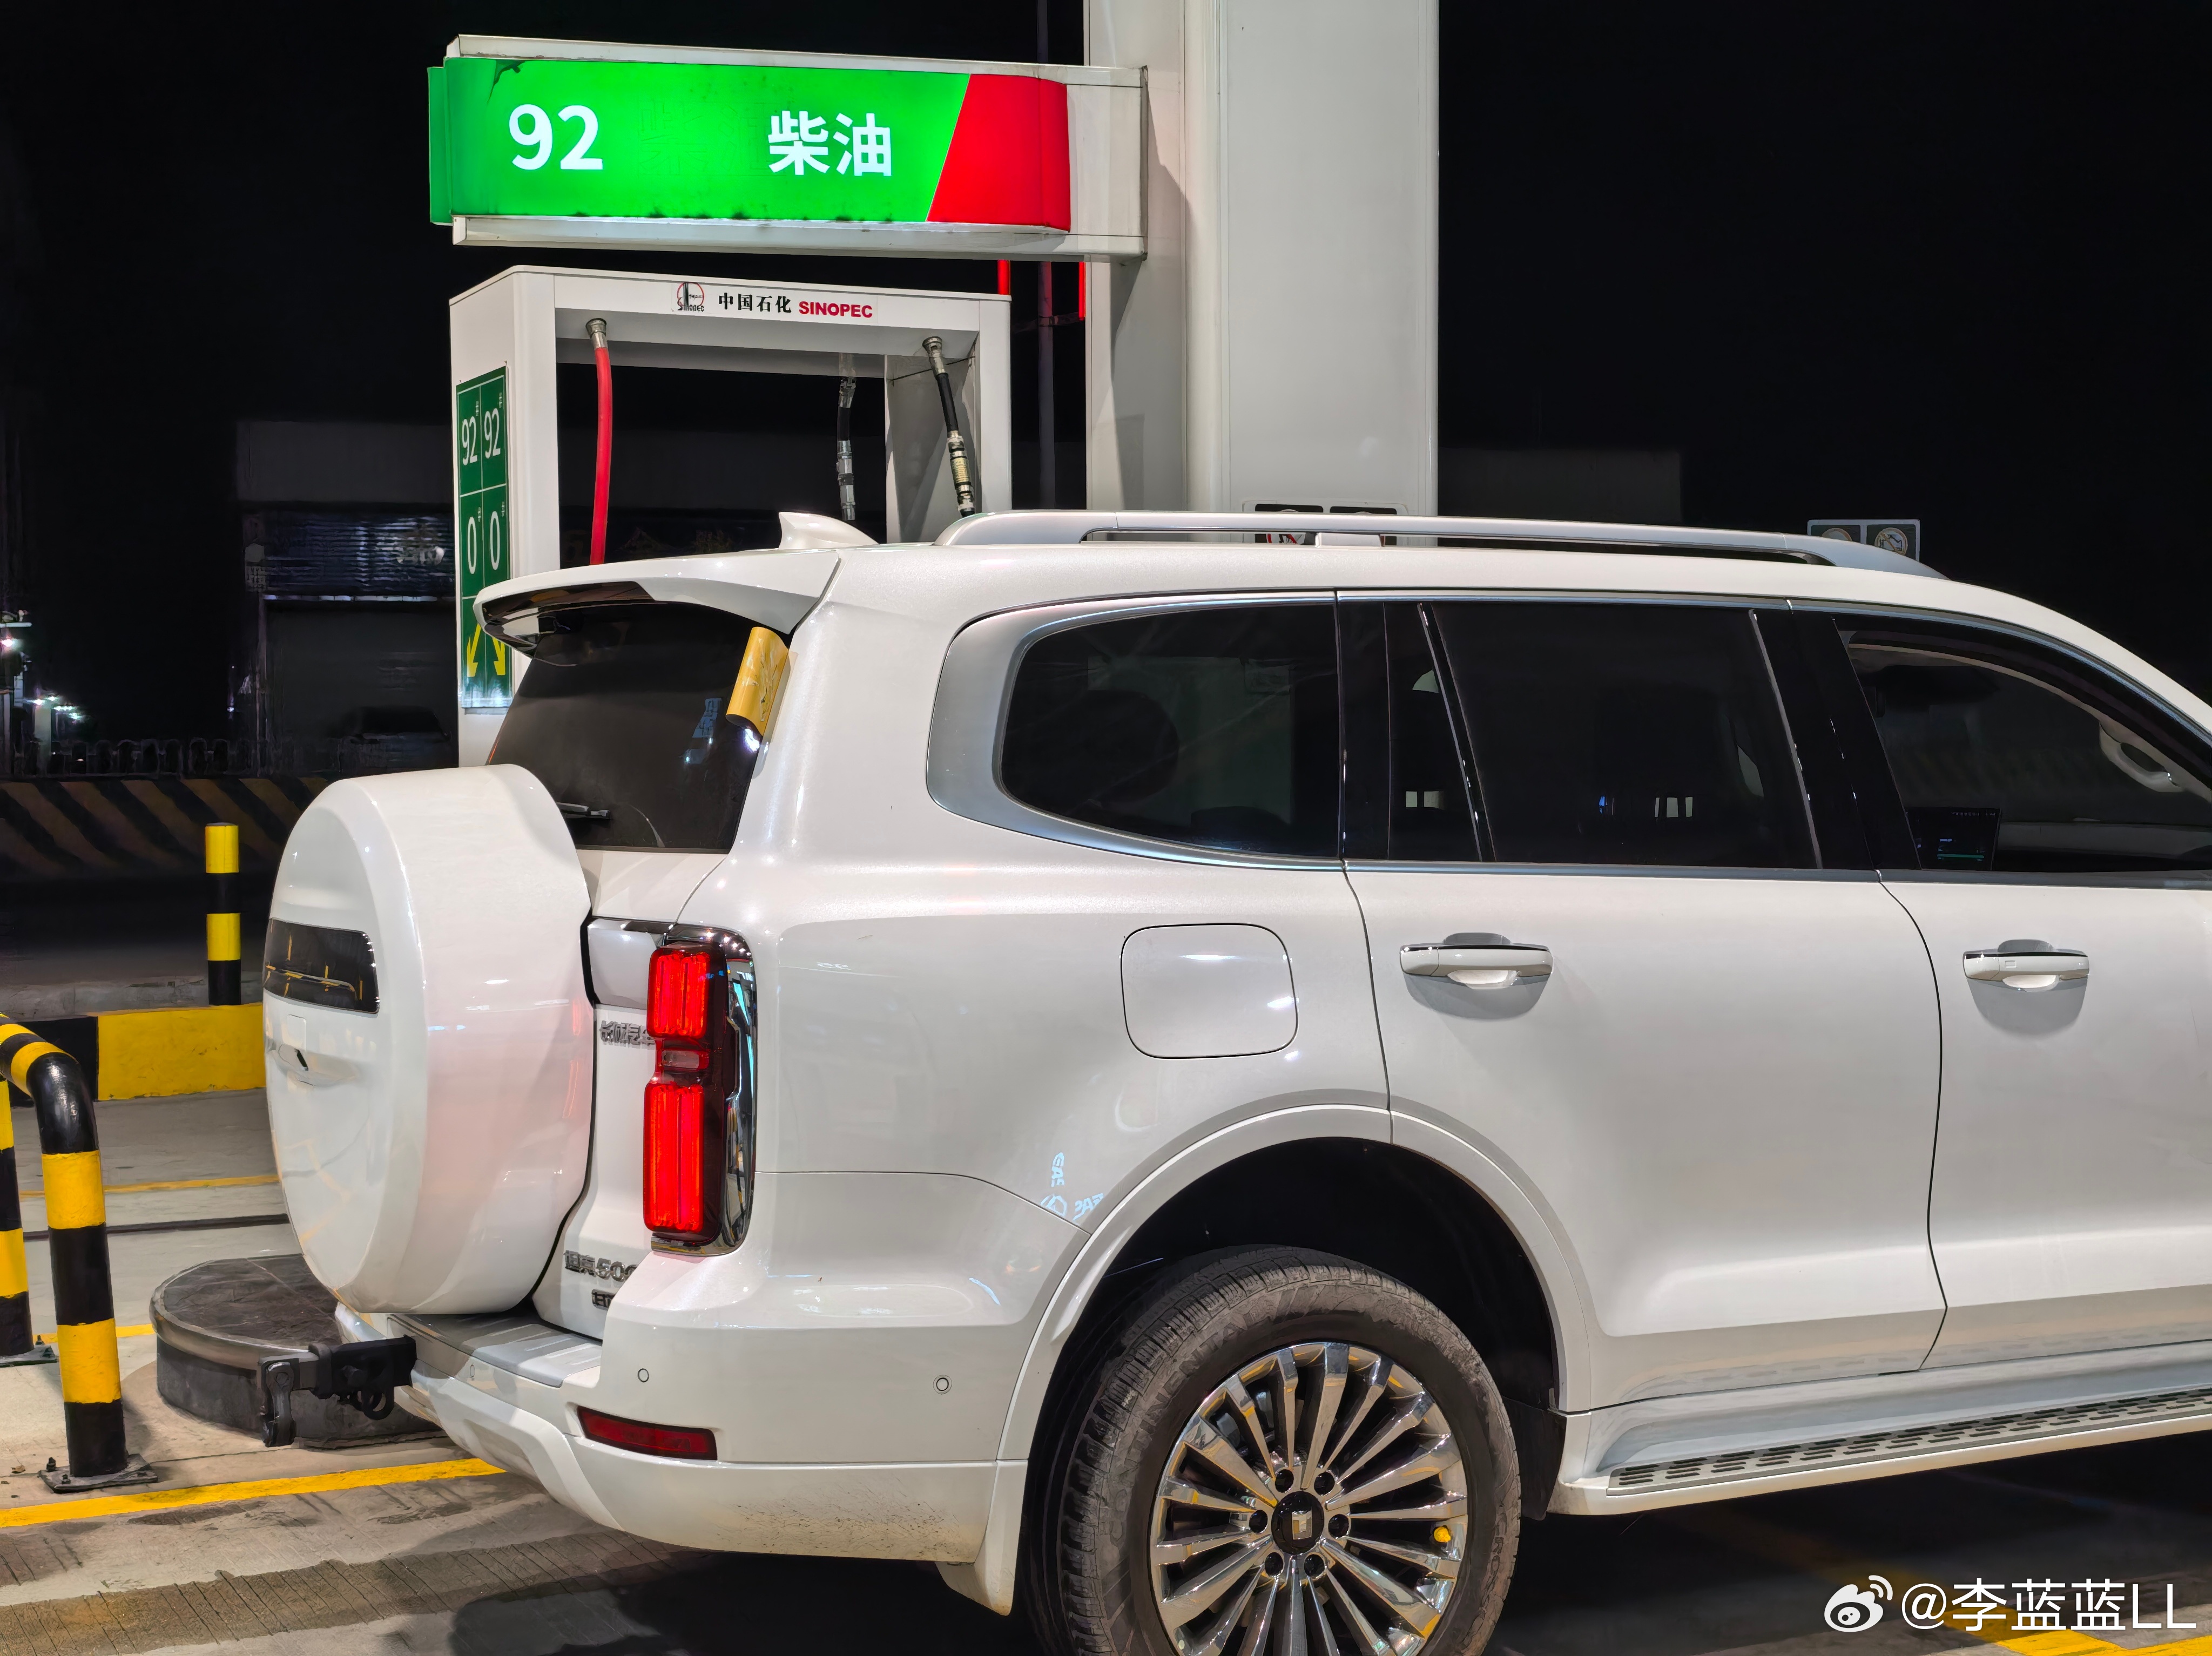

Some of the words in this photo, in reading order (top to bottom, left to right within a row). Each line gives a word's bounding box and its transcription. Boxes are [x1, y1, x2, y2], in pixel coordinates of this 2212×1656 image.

[509, 104, 603, 171] 92
[767, 110, 892, 177] 柴油
[719, 292, 792, 313] 中国石化
[799, 301, 873, 318] SINOPEC
[462, 416, 478, 465] 92
[484, 408, 501, 458] 92
[467, 516, 477, 574] 0
[490, 511, 500, 570] 0
